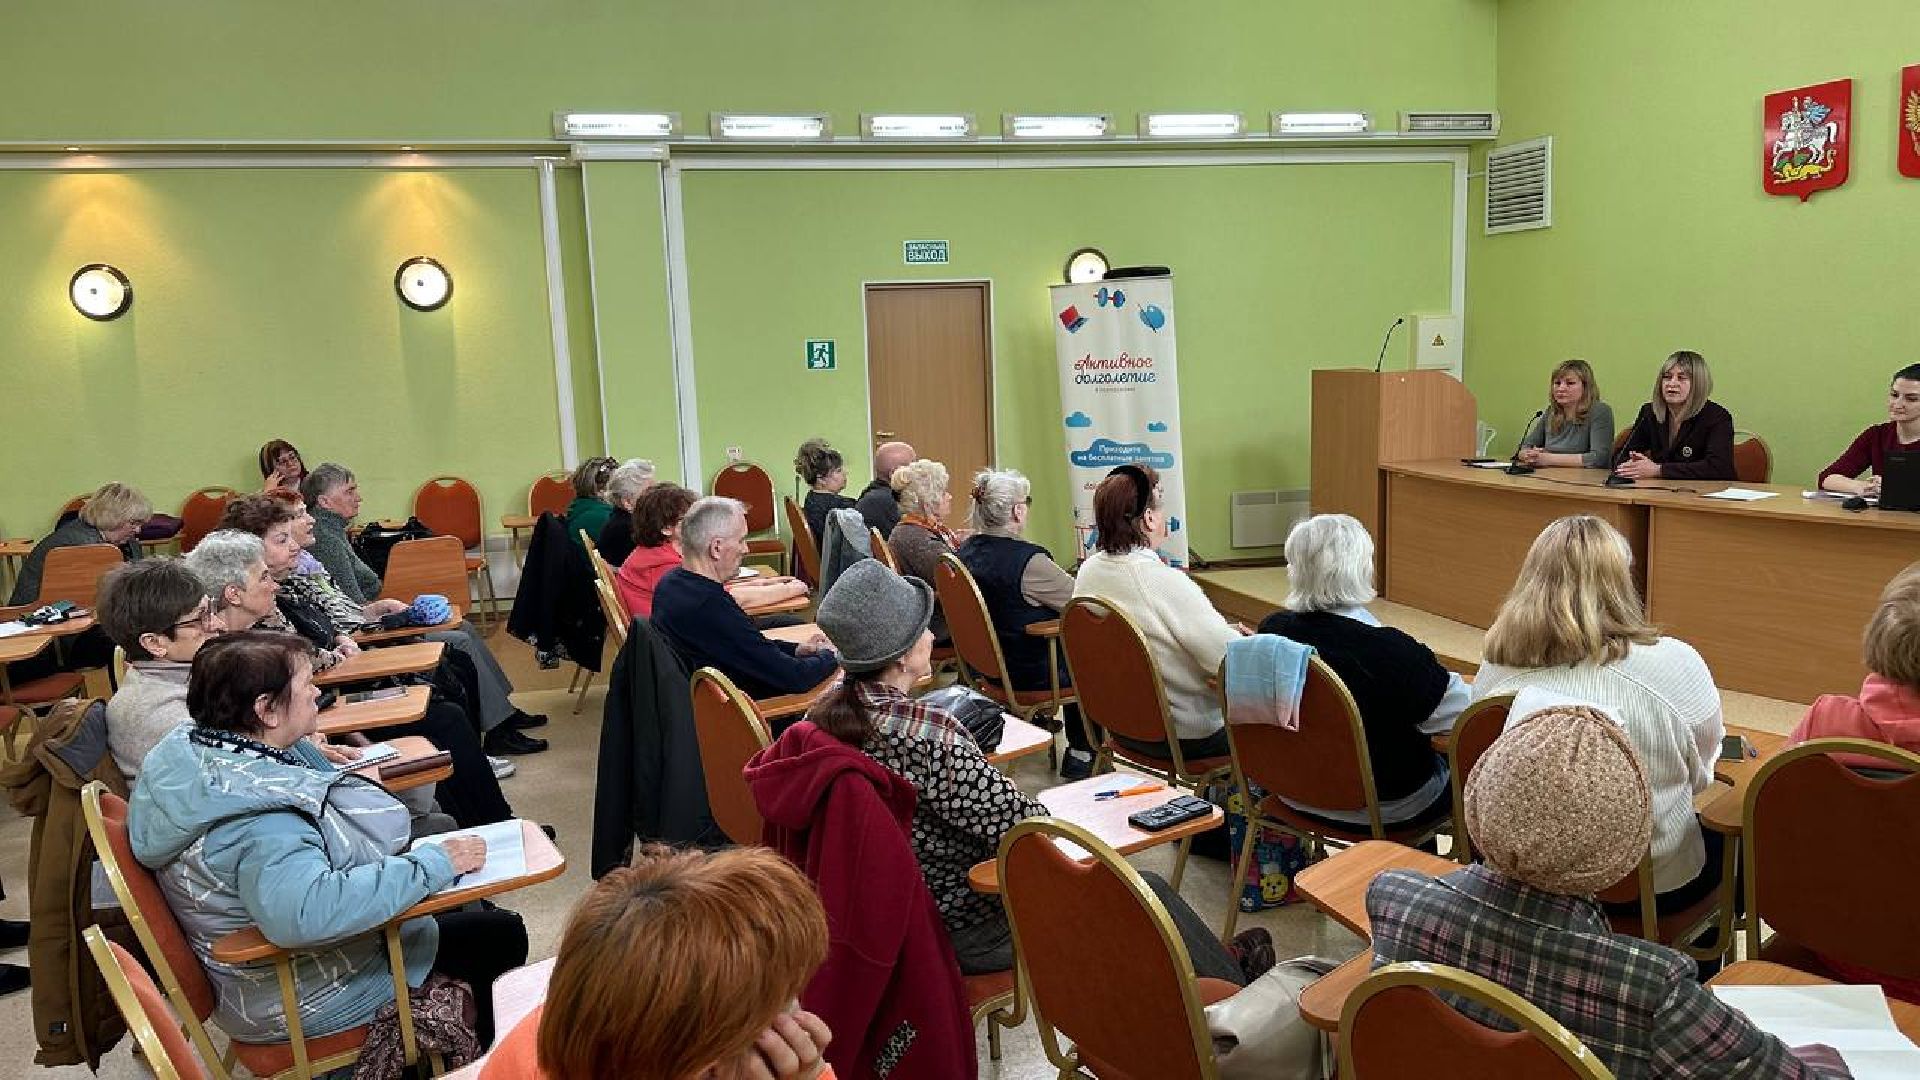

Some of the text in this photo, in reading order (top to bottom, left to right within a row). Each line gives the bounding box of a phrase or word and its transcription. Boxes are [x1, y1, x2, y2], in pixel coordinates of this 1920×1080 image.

[908, 250, 945, 261] ВЫХОД
[1074, 352, 1152, 370] Активное
[1075, 371, 1156, 385] долголетие
[1098, 444, 1141, 454] Приходите
